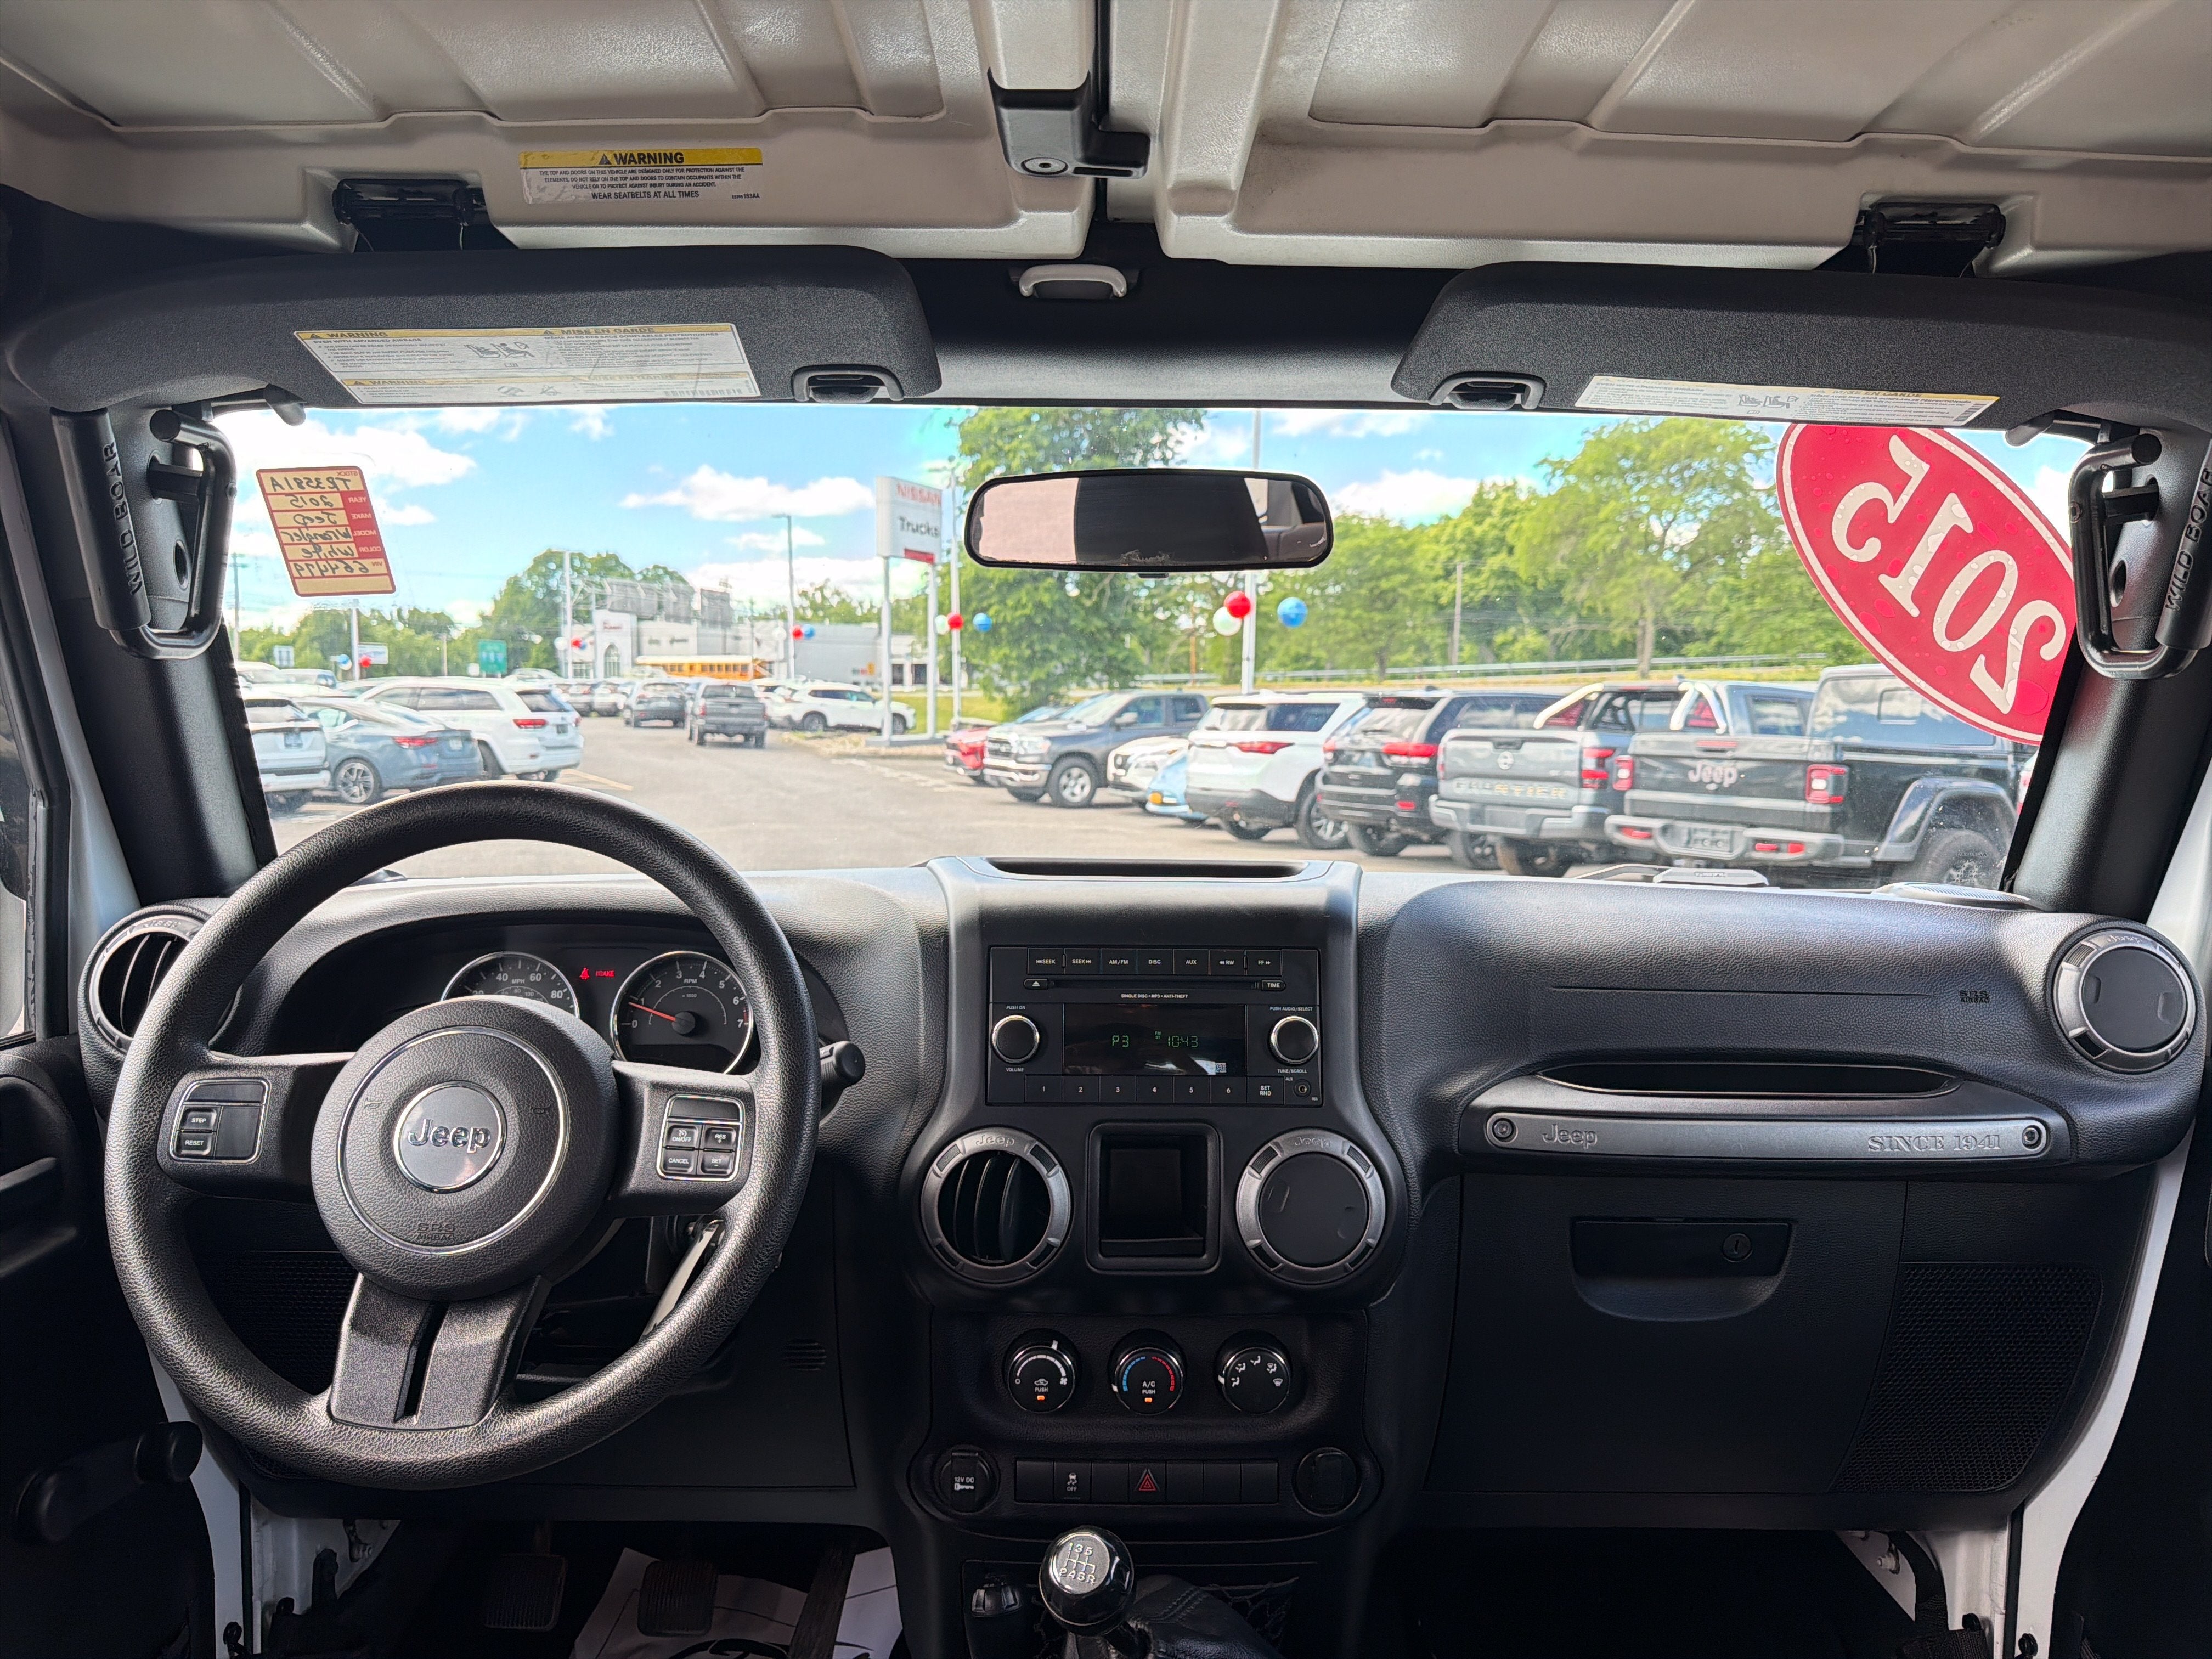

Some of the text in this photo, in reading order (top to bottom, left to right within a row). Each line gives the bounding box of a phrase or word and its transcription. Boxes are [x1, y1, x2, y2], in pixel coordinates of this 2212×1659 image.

[613, 152, 684, 165] WARNING
[102, 443, 143, 596] WILD BOAR
[899, 516, 940, 539] Trucks
[2165, 468, 2212, 611] WILD BOAR
[1688, 760, 1738, 788] Jeep
[496, 973, 509, 981] 40
[529, 973, 542, 981] 60
[676, 970, 682, 979] 3
[699, 970, 706, 979] 4
[655, 980, 662, 988] 2
[719, 980, 725, 989] 5
[550, 990, 563, 999] 80
[640, 997, 645, 1006] 1
[733, 996, 740, 1005] 6
[631, 1020, 638, 1028] 0
[737, 1019, 743, 1028] 7
[408, 1119, 491, 1153] Jeep
[975, 1134, 1014, 1147] Jeep
[1542, 1123, 1598, 1150] Jeep
[1295, 1136, 1331, 1148] Jeep
[1867, 1135, 2001, 1152] SINCE 1941
[417, 1222, 455, 1233] SRS
[1074, 1544, 1083, 1553] 3
[1085, 1546, 1093, 1555] 5
[1059, 1567, 1096, 1584] 2 4 6 R
